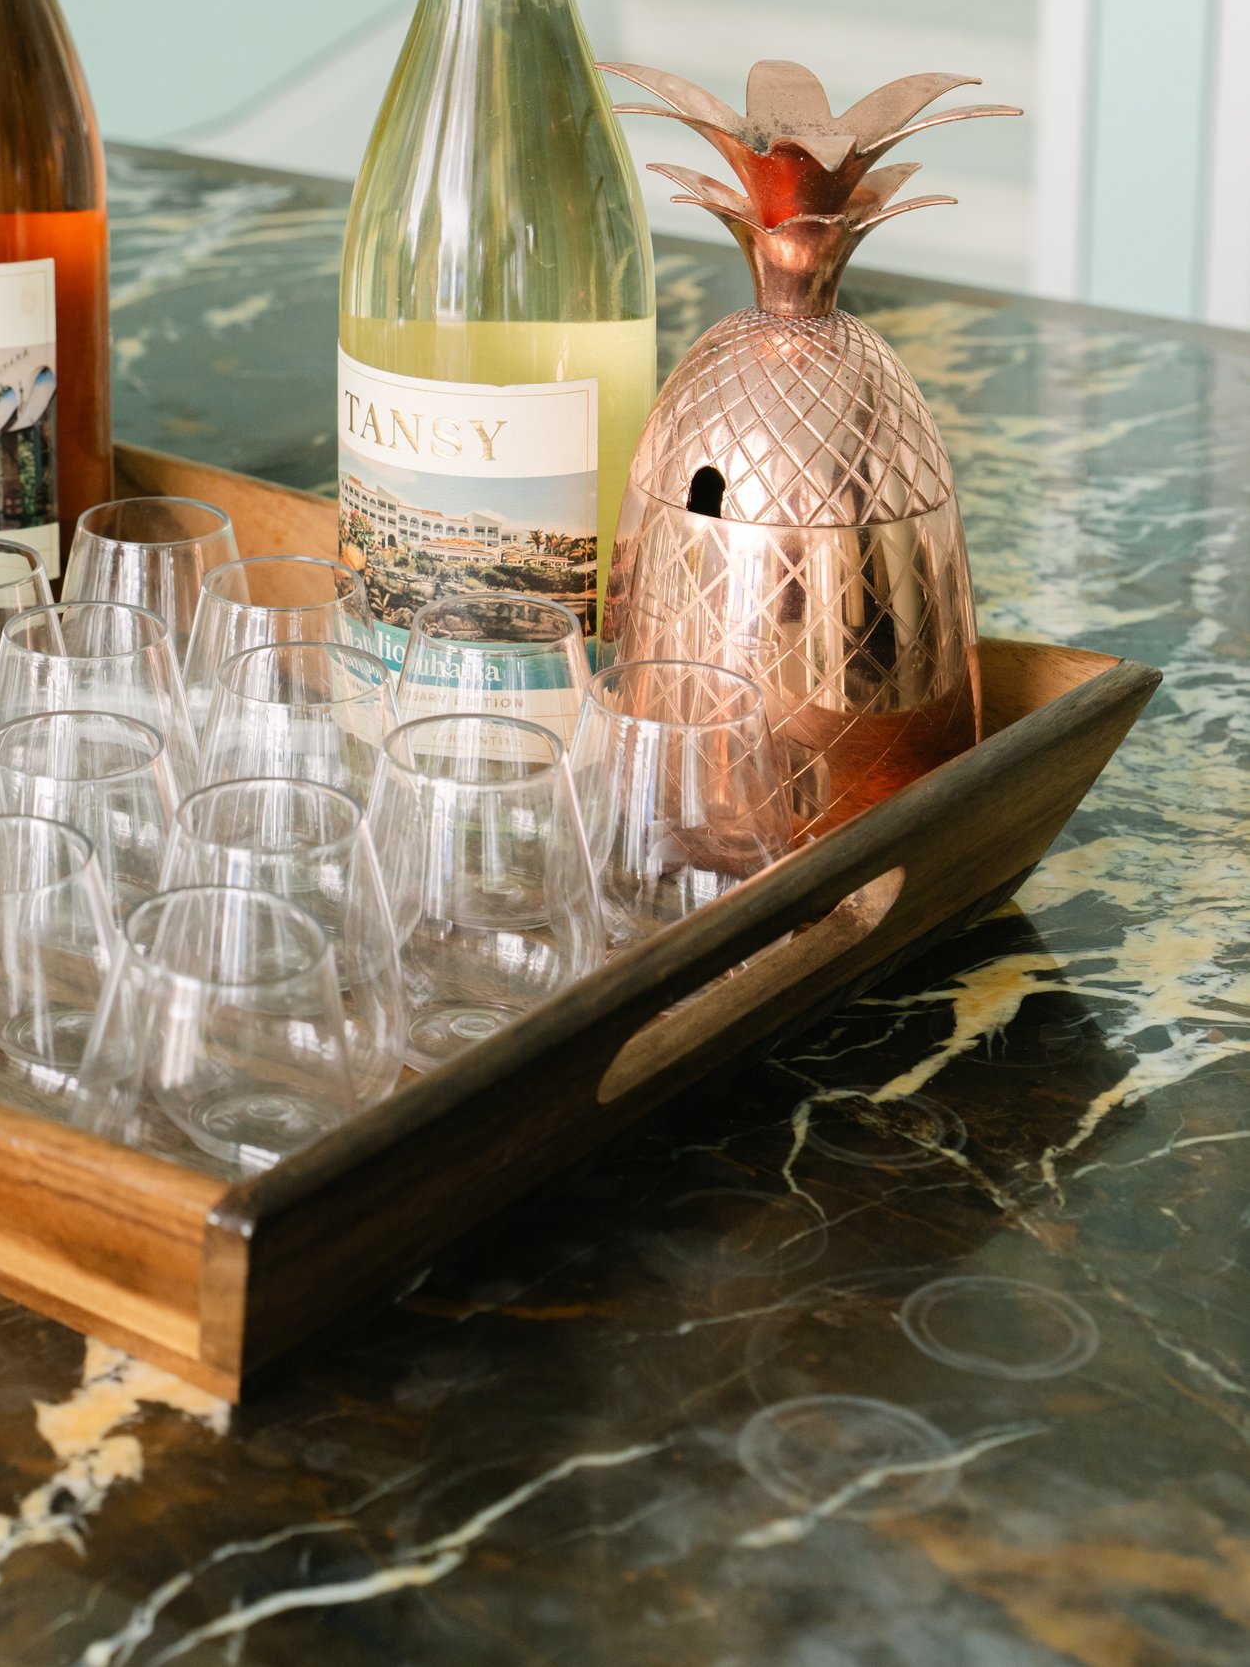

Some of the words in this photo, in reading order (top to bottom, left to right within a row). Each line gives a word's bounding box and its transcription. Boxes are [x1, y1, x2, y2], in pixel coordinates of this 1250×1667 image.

[343, 389, 507, 461] TANSY
[454, 695, 524, 709] EDTION
[431, 733, 524, 748] VERNTINO
